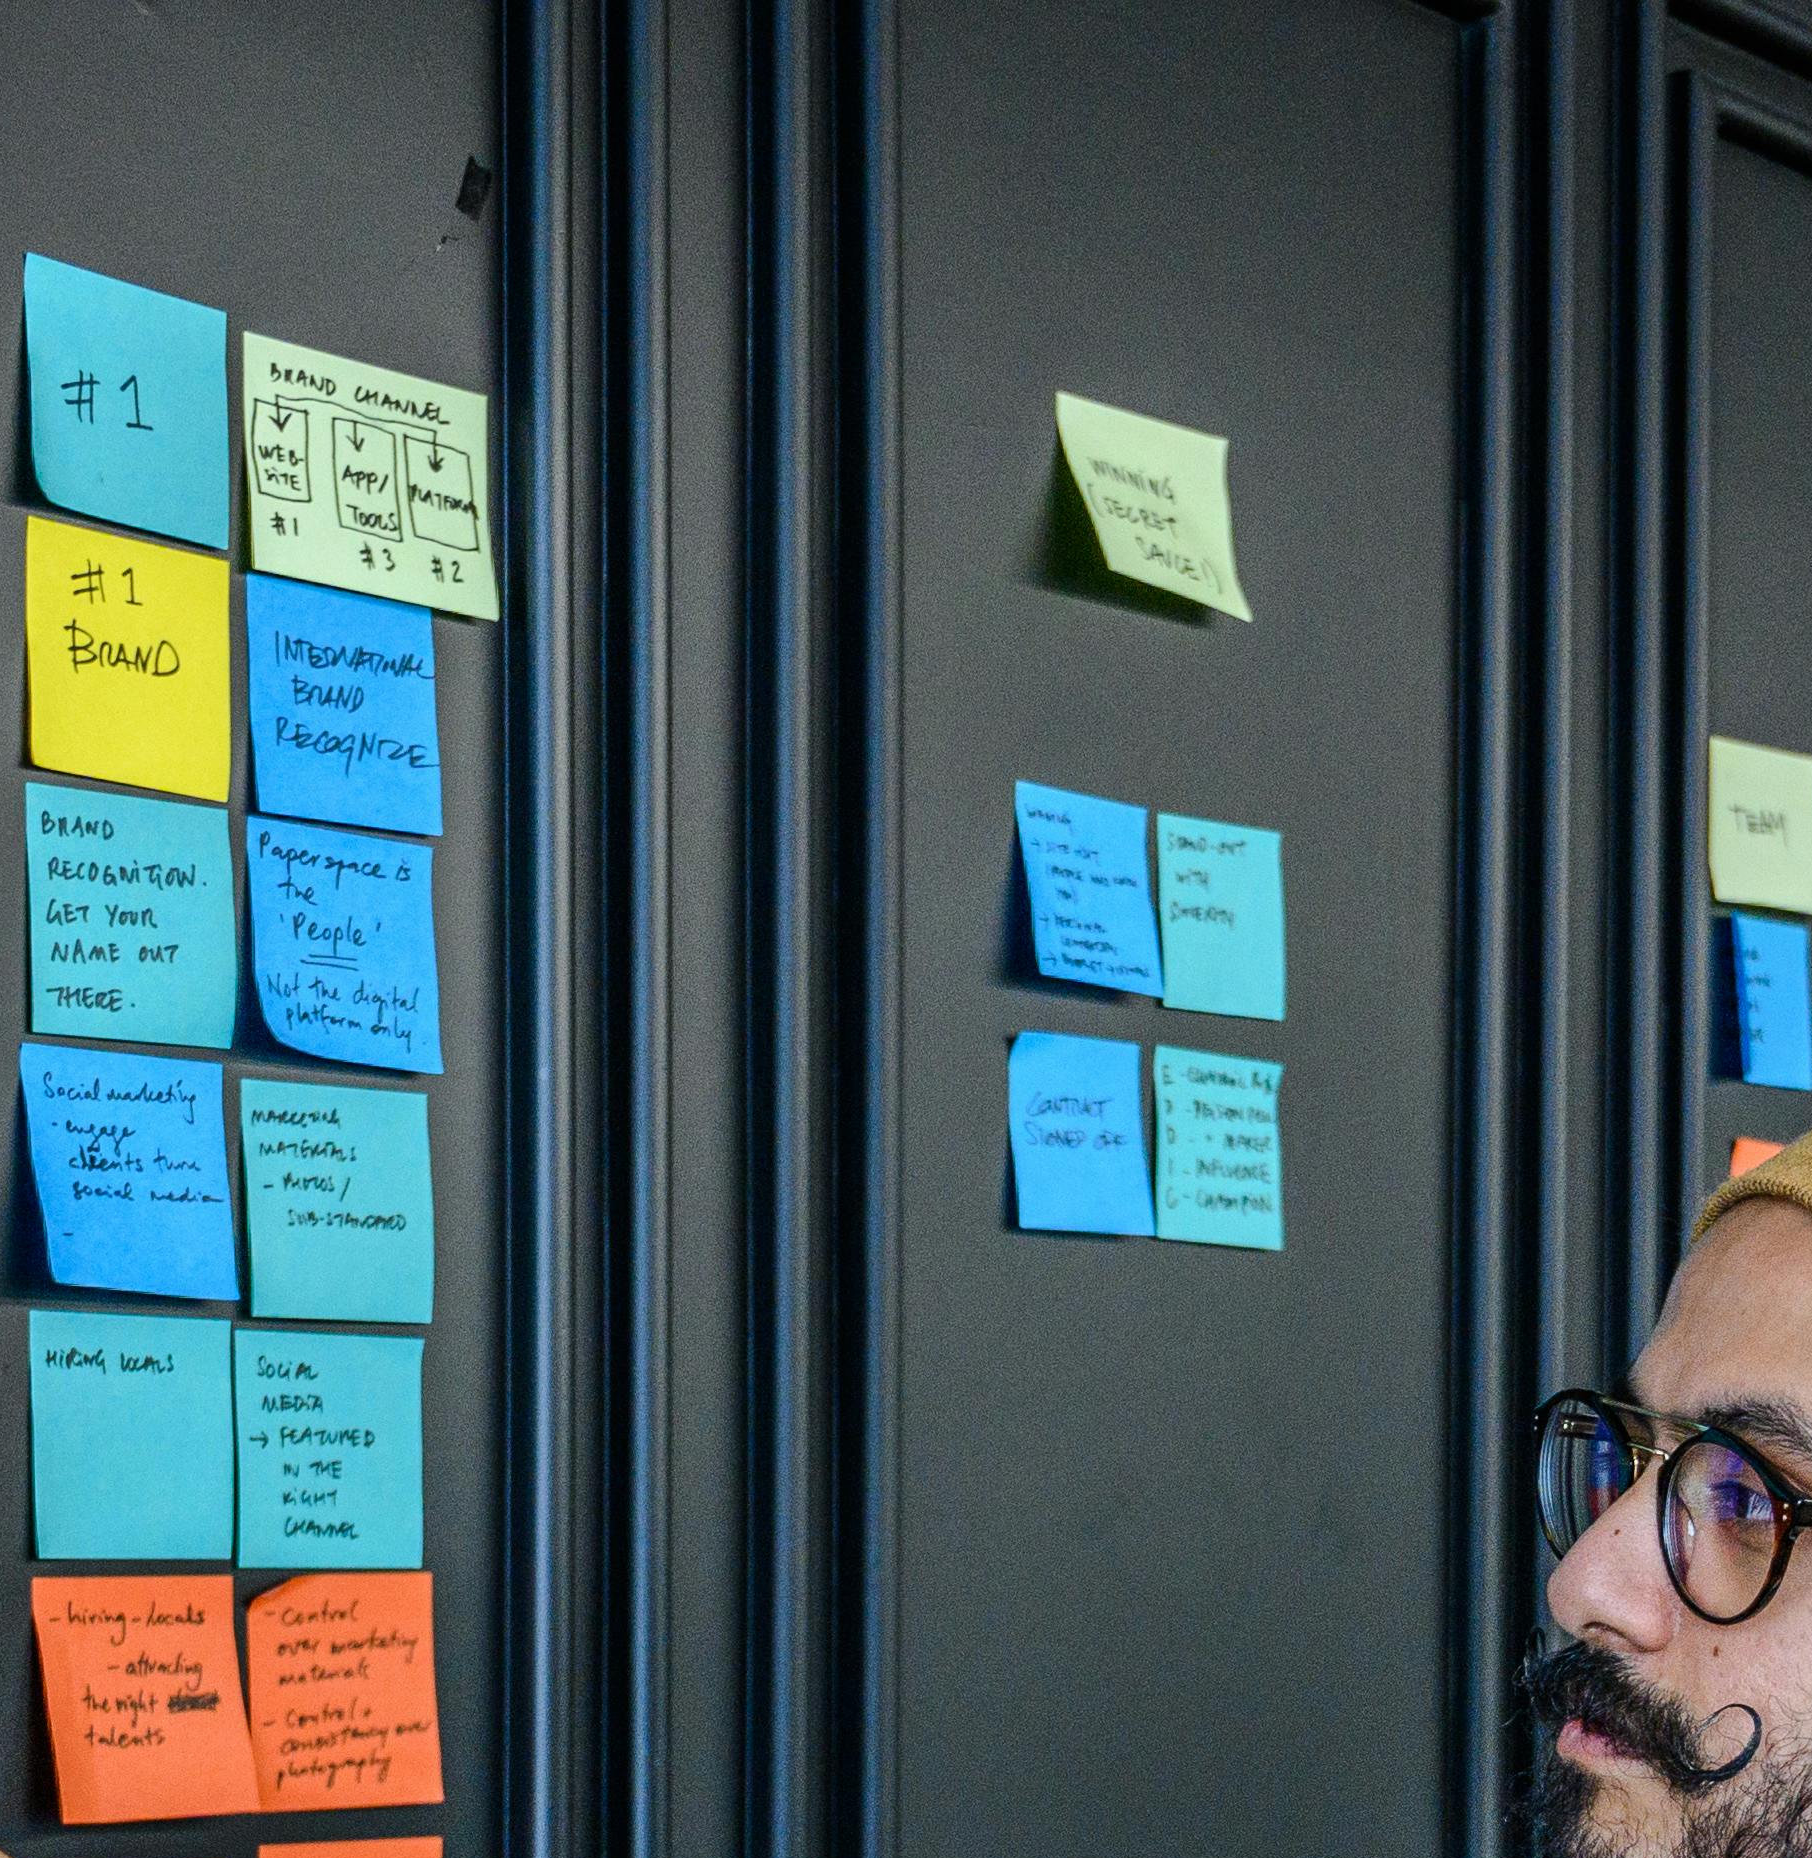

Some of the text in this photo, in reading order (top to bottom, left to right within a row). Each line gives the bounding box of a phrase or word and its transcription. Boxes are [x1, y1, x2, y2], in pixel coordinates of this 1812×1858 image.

[269, 362, 451, 426] BRAND CHANNEL
[345, 503, 400, 533] TOOLS
[63, 618, 182, 678] BRAND
[291, 673, 366, 714] BRAND
[40, 809, 115, 841] BRAND
[45, 898, 159, 930] GET YOUR
[50, 938, 180, 965] NAME OUT
[45, 1348, 107, 1375] HIRING
[257, 1355, 319, 1381] SOCIAL
[280, 1426, 377, 1449] FEATURED
[309, 1459, 343, 1480] THE
[283, 1515, 360, 1540] CHANNEL
